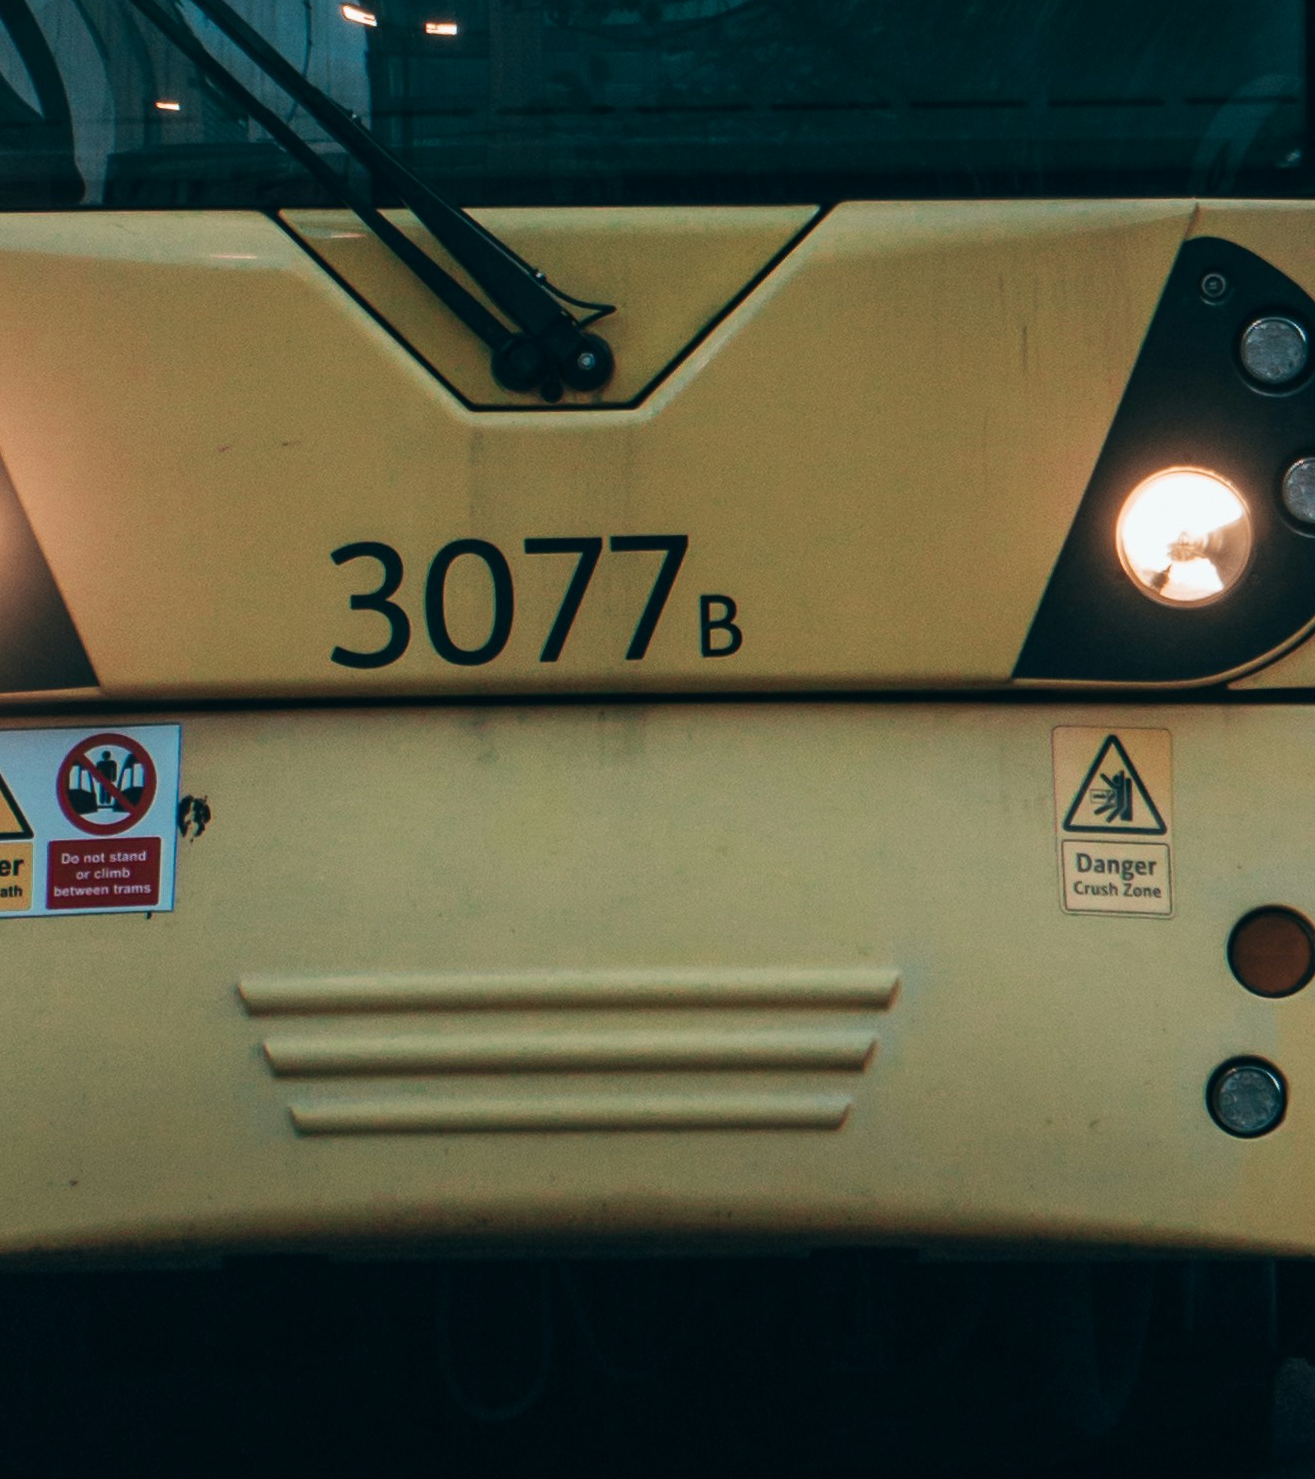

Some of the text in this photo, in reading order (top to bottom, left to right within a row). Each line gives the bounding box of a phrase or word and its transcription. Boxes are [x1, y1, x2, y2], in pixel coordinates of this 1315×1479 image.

[61, 850, 147, 864] Do not stand
[75, 867, 130, 880] or climb
[1075, 852, 1157, 881] Danger
[53, 884, 152, 897] between trams
[1073, 880, 1162, 898] Crush Zone
